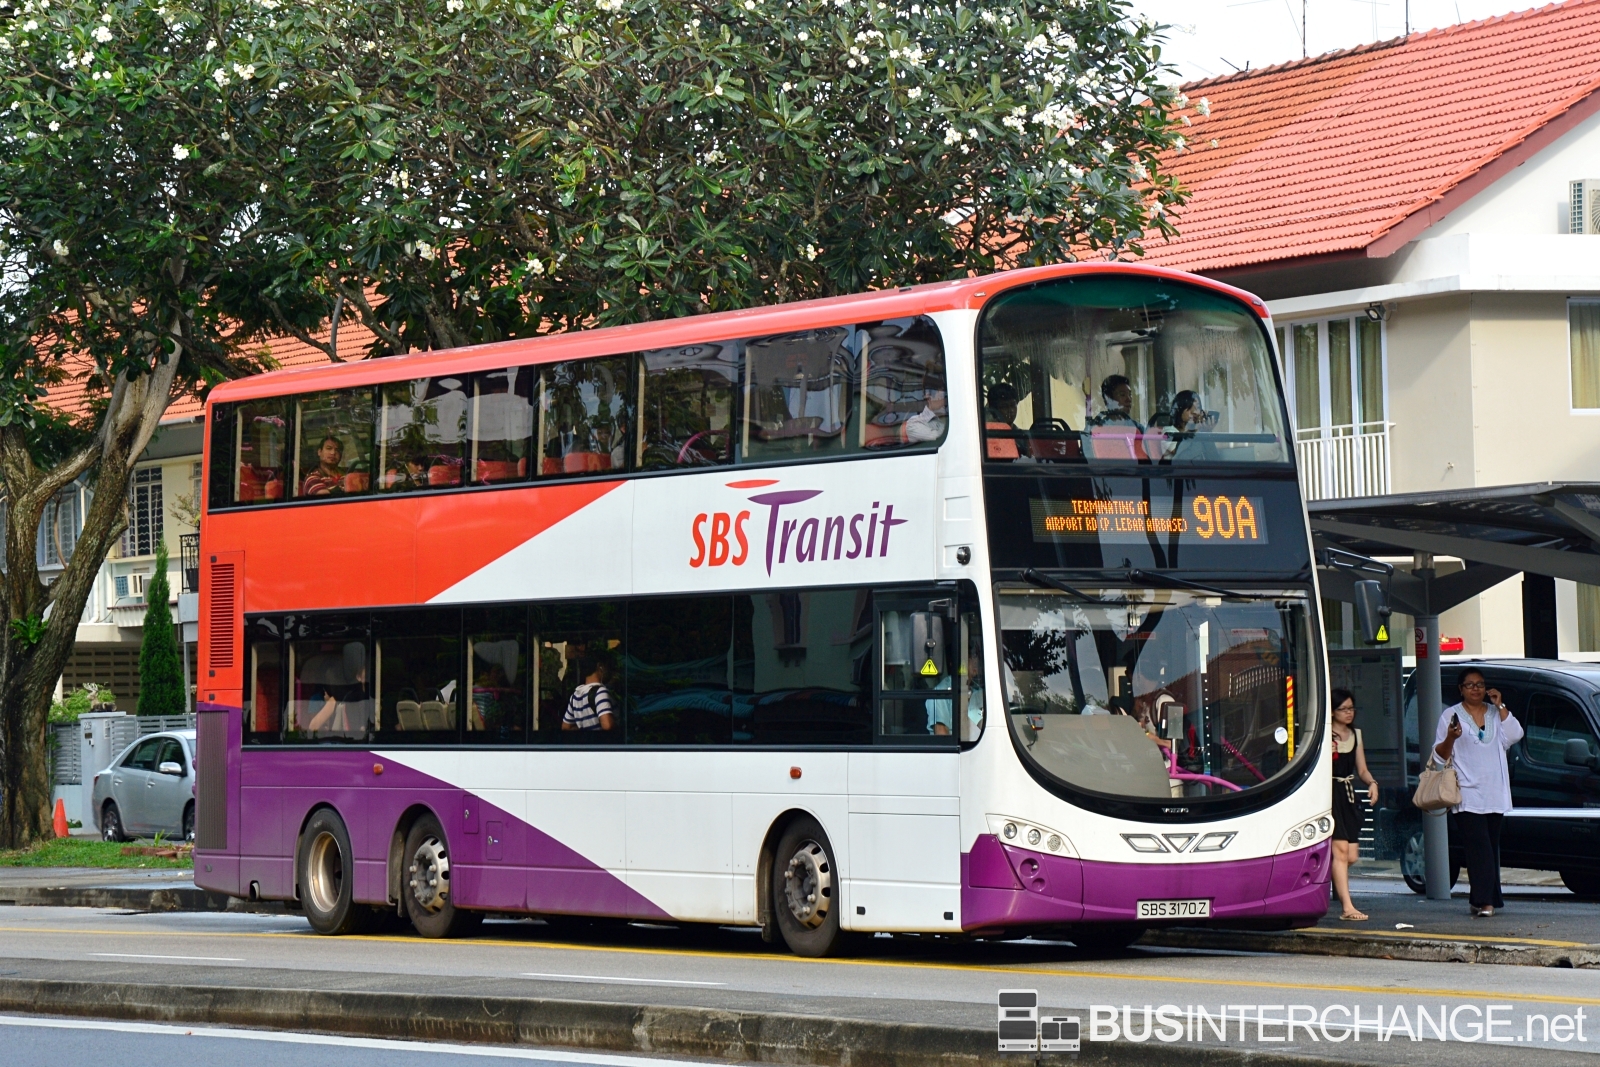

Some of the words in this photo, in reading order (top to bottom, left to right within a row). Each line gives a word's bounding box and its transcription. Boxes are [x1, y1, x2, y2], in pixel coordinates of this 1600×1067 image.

[1071, 499, 1135, 514] TERMINATING
[1137, 500, 1148, 514] AT
[1193, 495, 1257, 539] 90A
[689, 510, 750, 568] SBS
[747, 489, 909, 578] Transit
[1046, 516, 1082, 531] AIRPORT
[1086, 517, 1098, 531] RD
[1115, 517, 1144, 531] LEBAR
[1146, 517, 1188, 532] AIRBASE)
